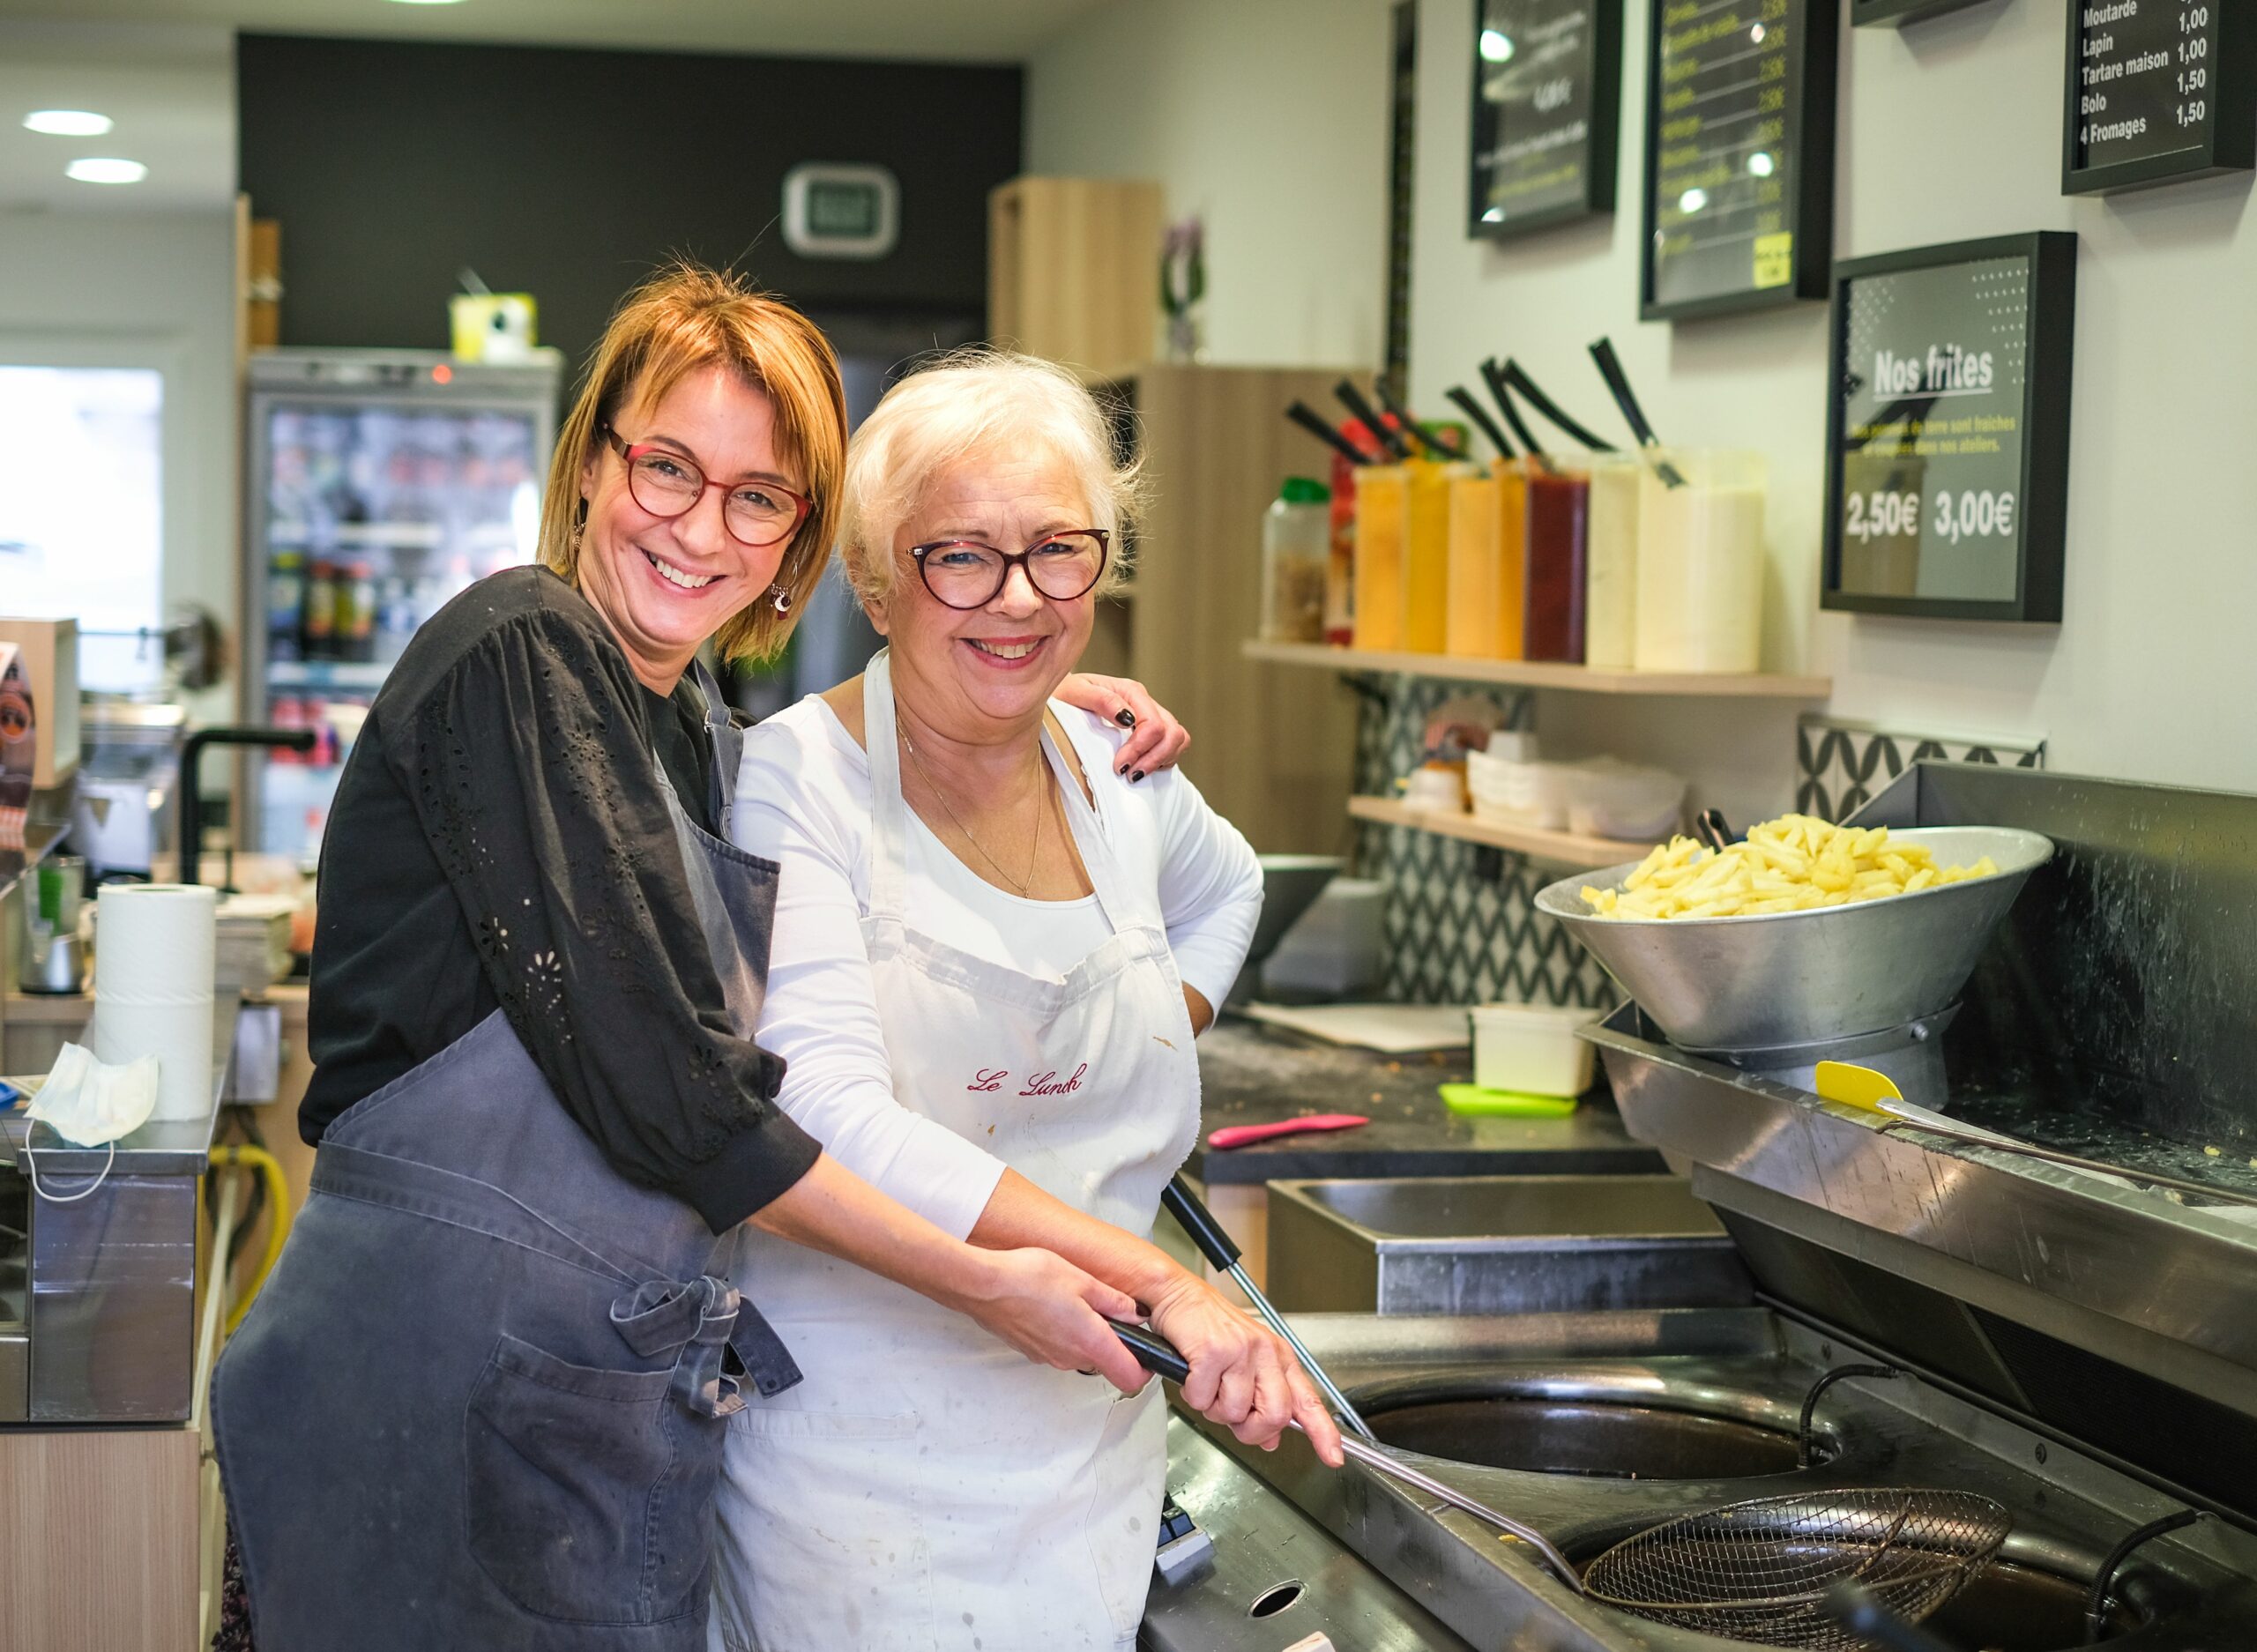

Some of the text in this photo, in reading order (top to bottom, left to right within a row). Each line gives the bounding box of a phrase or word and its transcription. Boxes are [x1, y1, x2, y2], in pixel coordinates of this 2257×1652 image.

[2082, 7, 2208, 58] Lapin 1,00
[2083, 0, 2137, 28] Moutarde
[2082, 38, 2207, 86] Tartare maison 1,00
[2081, 69, 2206, 115] Bolo 1,50
[2080, 100, 2205, 145] 4 Fromages 1,50
[1874, 343, 1993, 394] Nos frites
[1846, 489, 2015, 546] 2,50€ 3,00€
[967, 1068, 1008, 1092] Le
